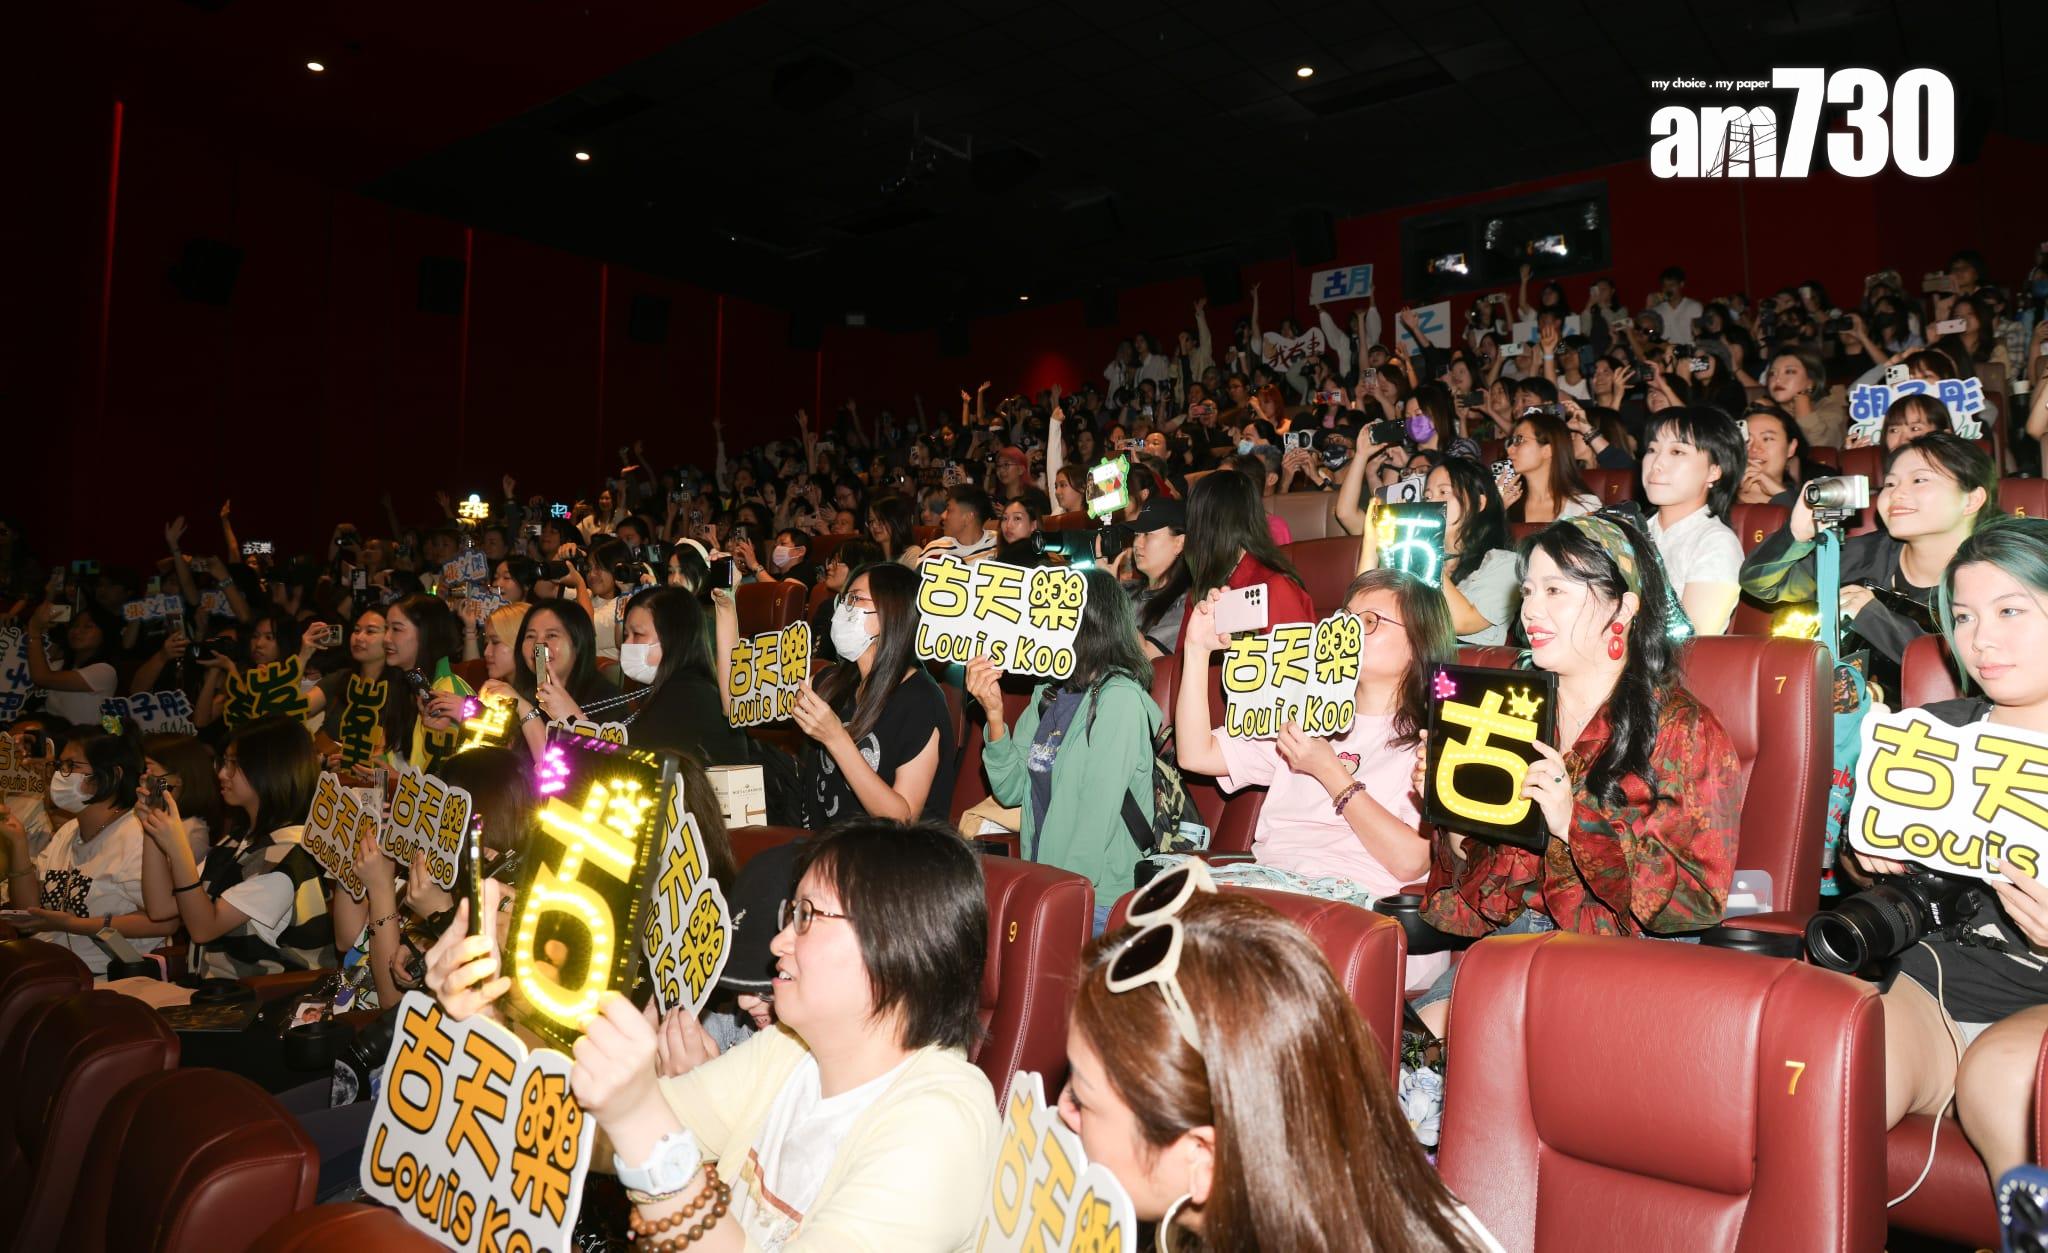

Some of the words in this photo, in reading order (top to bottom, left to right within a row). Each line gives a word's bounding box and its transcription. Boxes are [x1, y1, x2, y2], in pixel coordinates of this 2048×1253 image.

[1324, 266, 1372, 299] 胡
[1754, 530, 1764, 543] 6
[919, 558, 1084, 631] 古天樂
[729, 623, 808, 697] 古天樂
[917, 624, 1007, 667] Louis
[1013, 635, 1073, 676] Koo
[1225, 616, 1361, 692] 古天樂
[729, 692, 772, 726] Louis
[776, 688, 796, 718] Ko
[1775, 676, 1787, 694] 7
[1303, 695, 1355, 732] Koo
[1436, 690, 1539, 825] 古
[393, 771, 467, 853] 古天樂
[304, 822, 341, 873] Louis
[426, 847, 454, 885] Koo
[1862, 806, 2039, 880] Louis
[515, 779, 638, 1031] 古
[1930, 902, 1941, 925] Nikon
[1008, 921, 1018, 942] 9
[1785, 1060, 1805, 1096] 7
[388, 1003, 584, 1228] 古天樂
[371, 1122, 477, 1246] Louis
